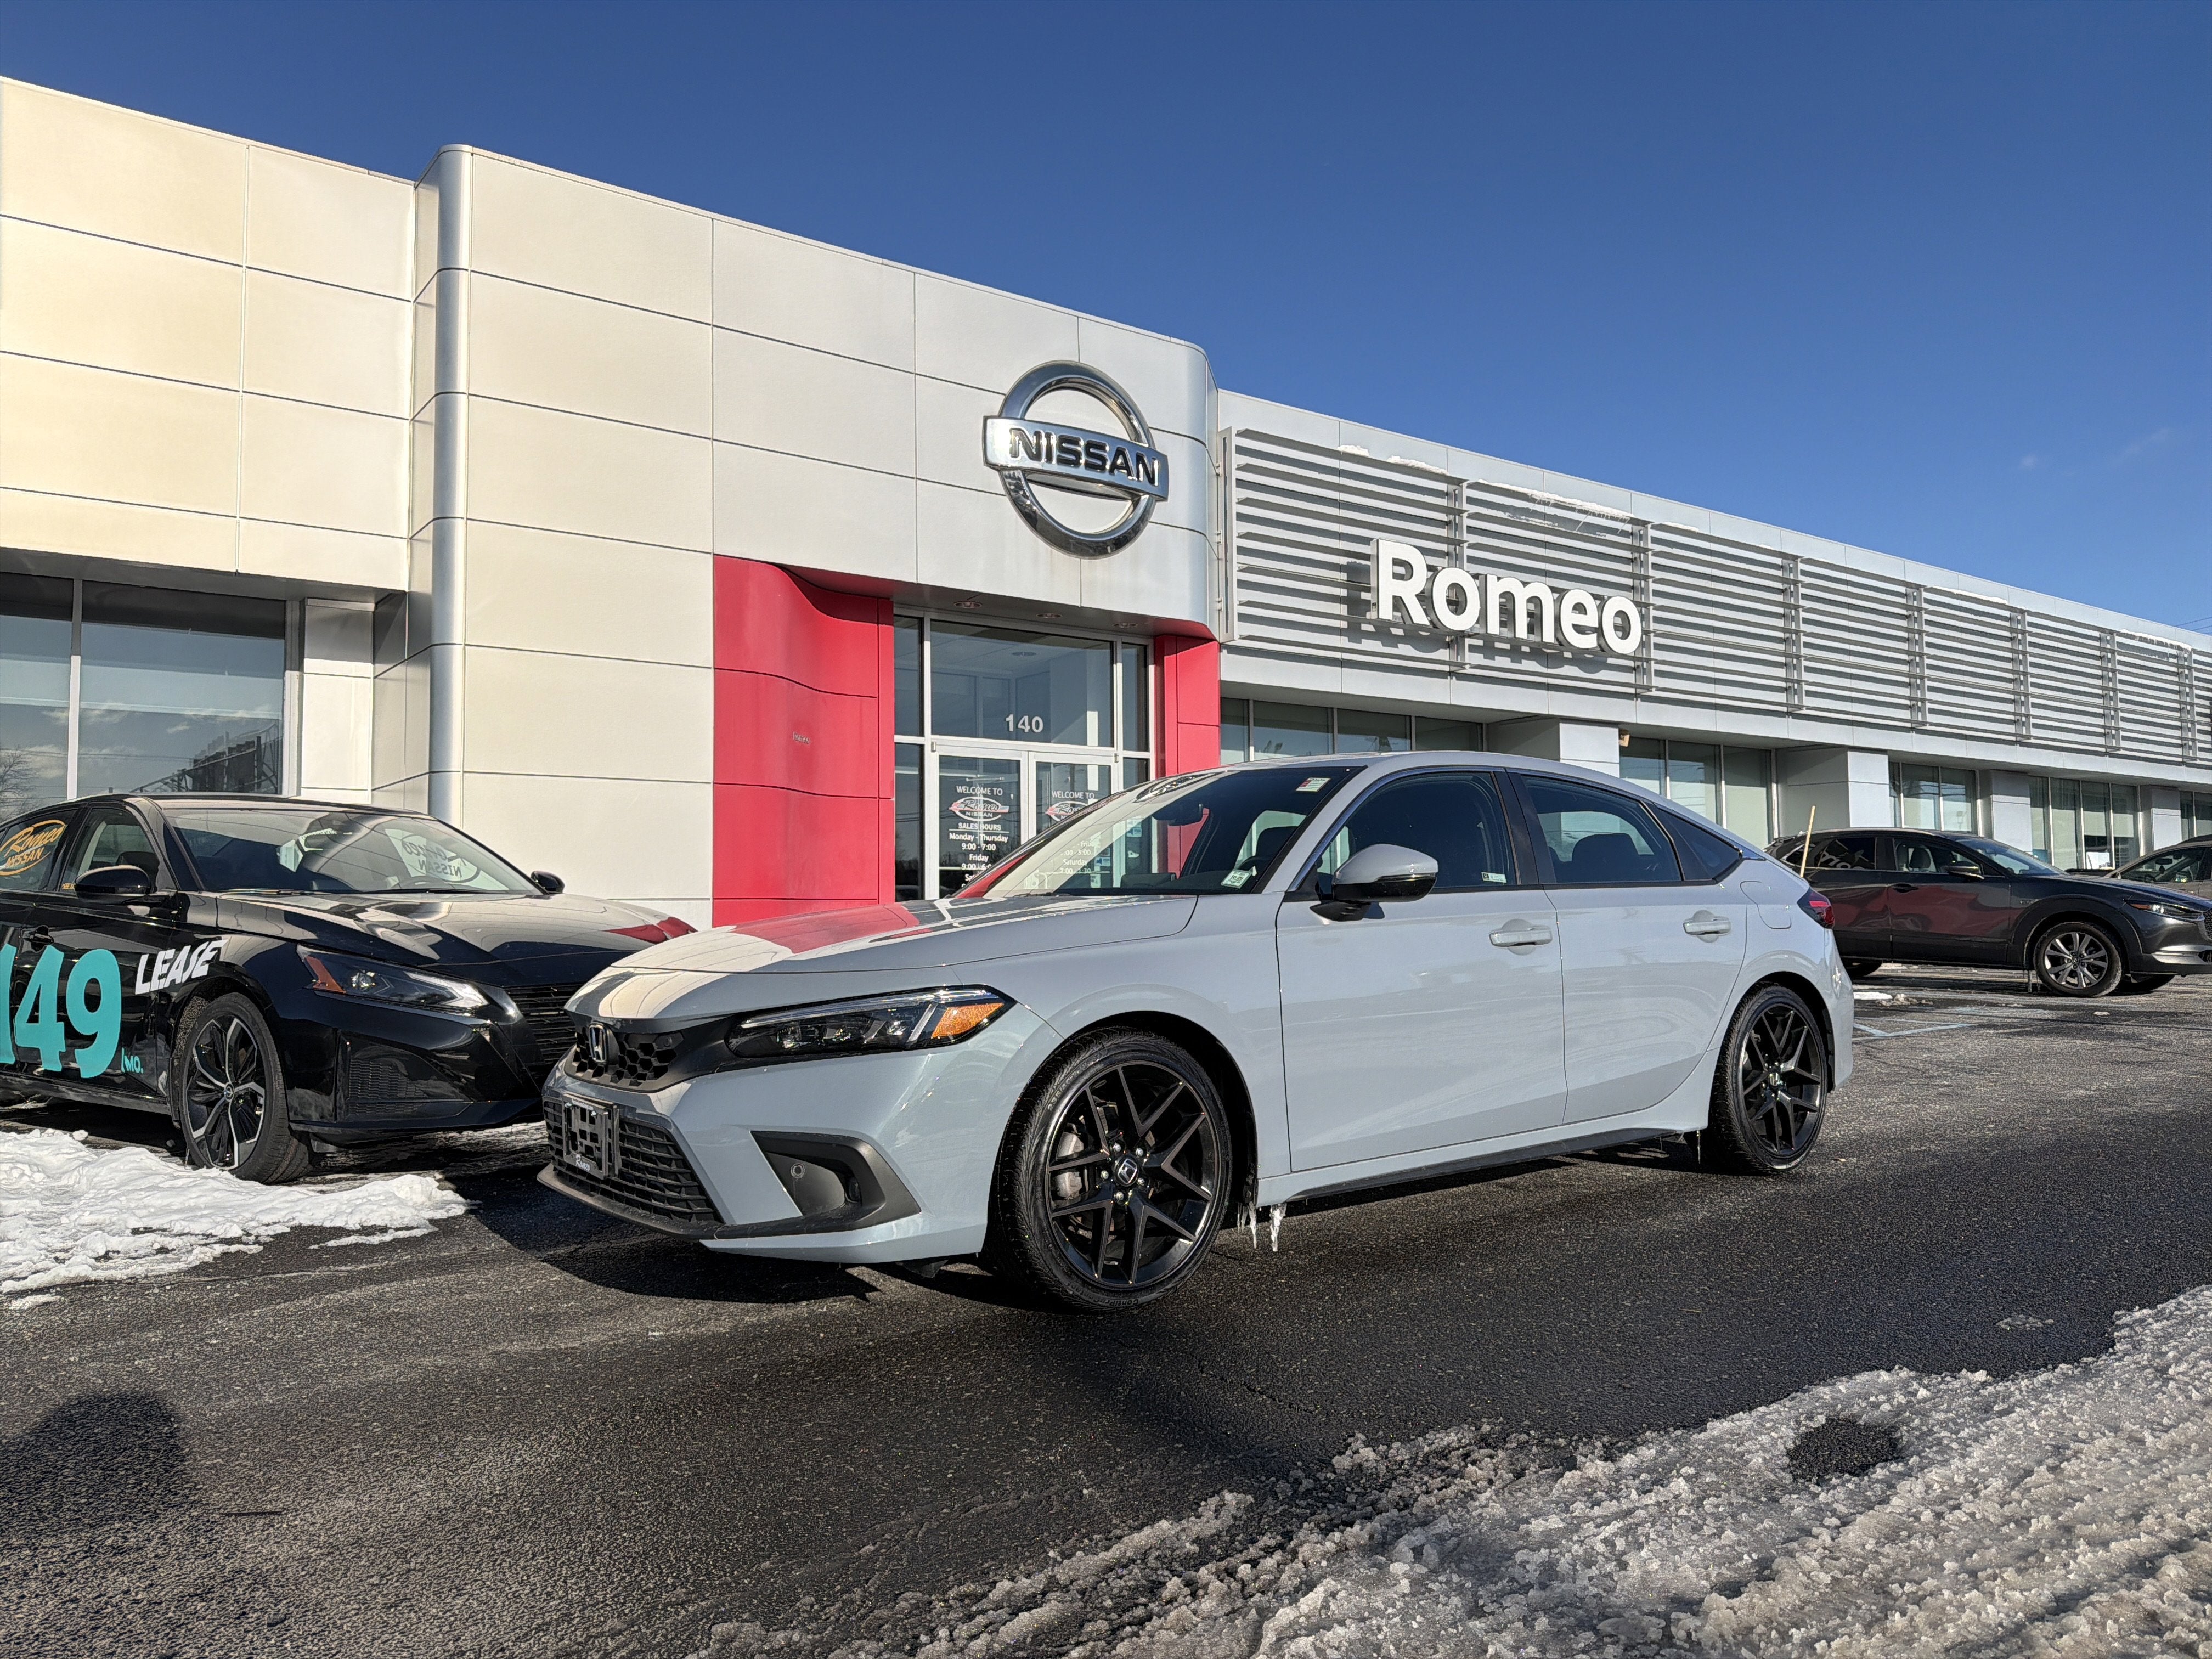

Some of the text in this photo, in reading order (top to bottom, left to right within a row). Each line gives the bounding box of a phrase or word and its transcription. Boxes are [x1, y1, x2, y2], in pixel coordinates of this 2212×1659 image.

[1009, 427, 1160, 486] NISSAN
[1373, 538, 1642, 655] Romeo
[1006, 714, 1043, 733] 140
[956, 785, 1003, 796] WELCOME TO
[1052, 791, 1084, 799] WELCOME
[962, 798, 1000, 811] Romeo
[0, 825, 65, 858] Romeo
[949, 833, 975, 842] Monday
[979, 833, 1008, 843] Thursday
[6, 847, 44, 867] NISSAN
[969, 853, 989, 862] Friday
[1063, 858, 1087, 867] Saturday
[134, 939, 229, 995] LEASE
[0, 943, 122, 1079] 149
